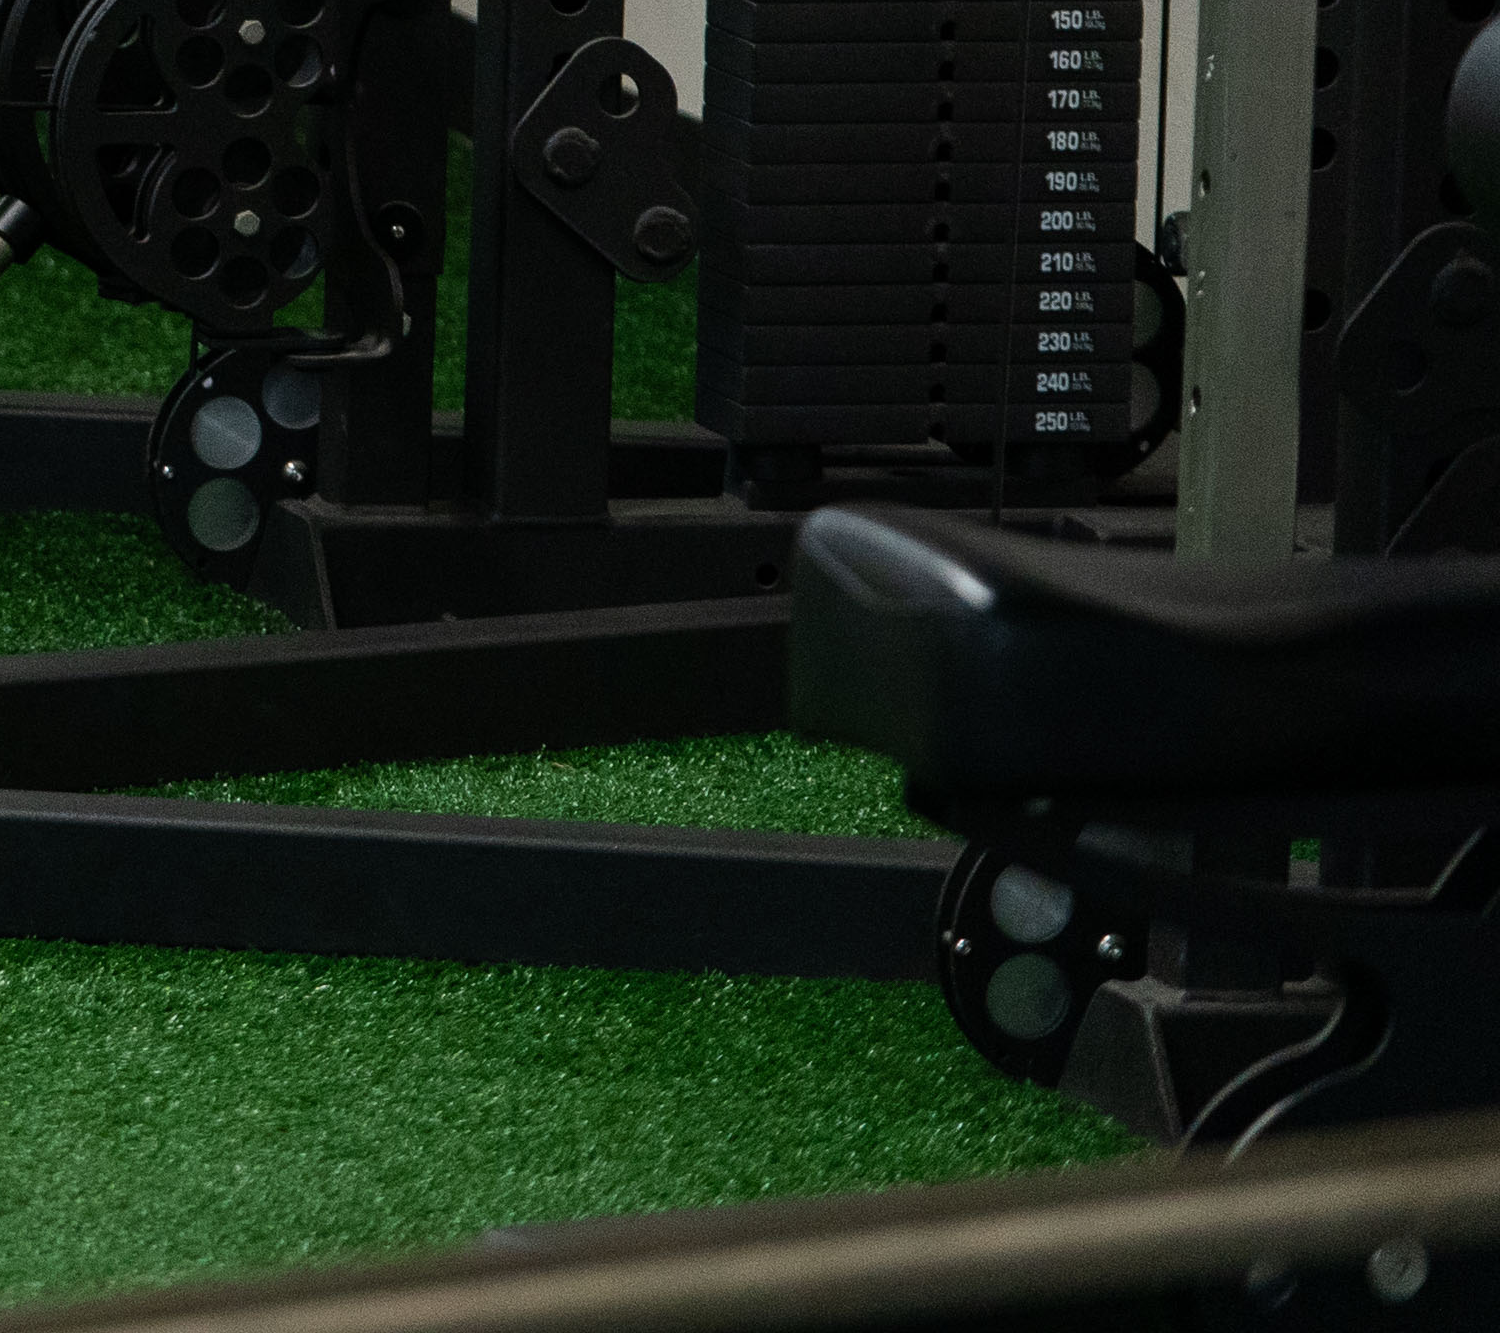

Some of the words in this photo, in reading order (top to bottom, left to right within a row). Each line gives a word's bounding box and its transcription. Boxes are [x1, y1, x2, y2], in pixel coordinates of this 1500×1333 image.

[1051, 10, 1083, 30] 150
[1049, 50, 1082, 70] 160
[1048, 89, 1080, 109] 170
[1047, 131, 1079, 151] 180
[1045, 171, 1078, 191] 190
[1040, 211, 1073, 231] 200
[1040, 252, 1074, 272] 210
[1039, 291, 1072, 311] 220
[1037, 332, 1071, 352] 230
[1036, 372, 1070, 392] 240
[1035, 411, 1068, 432] 250
